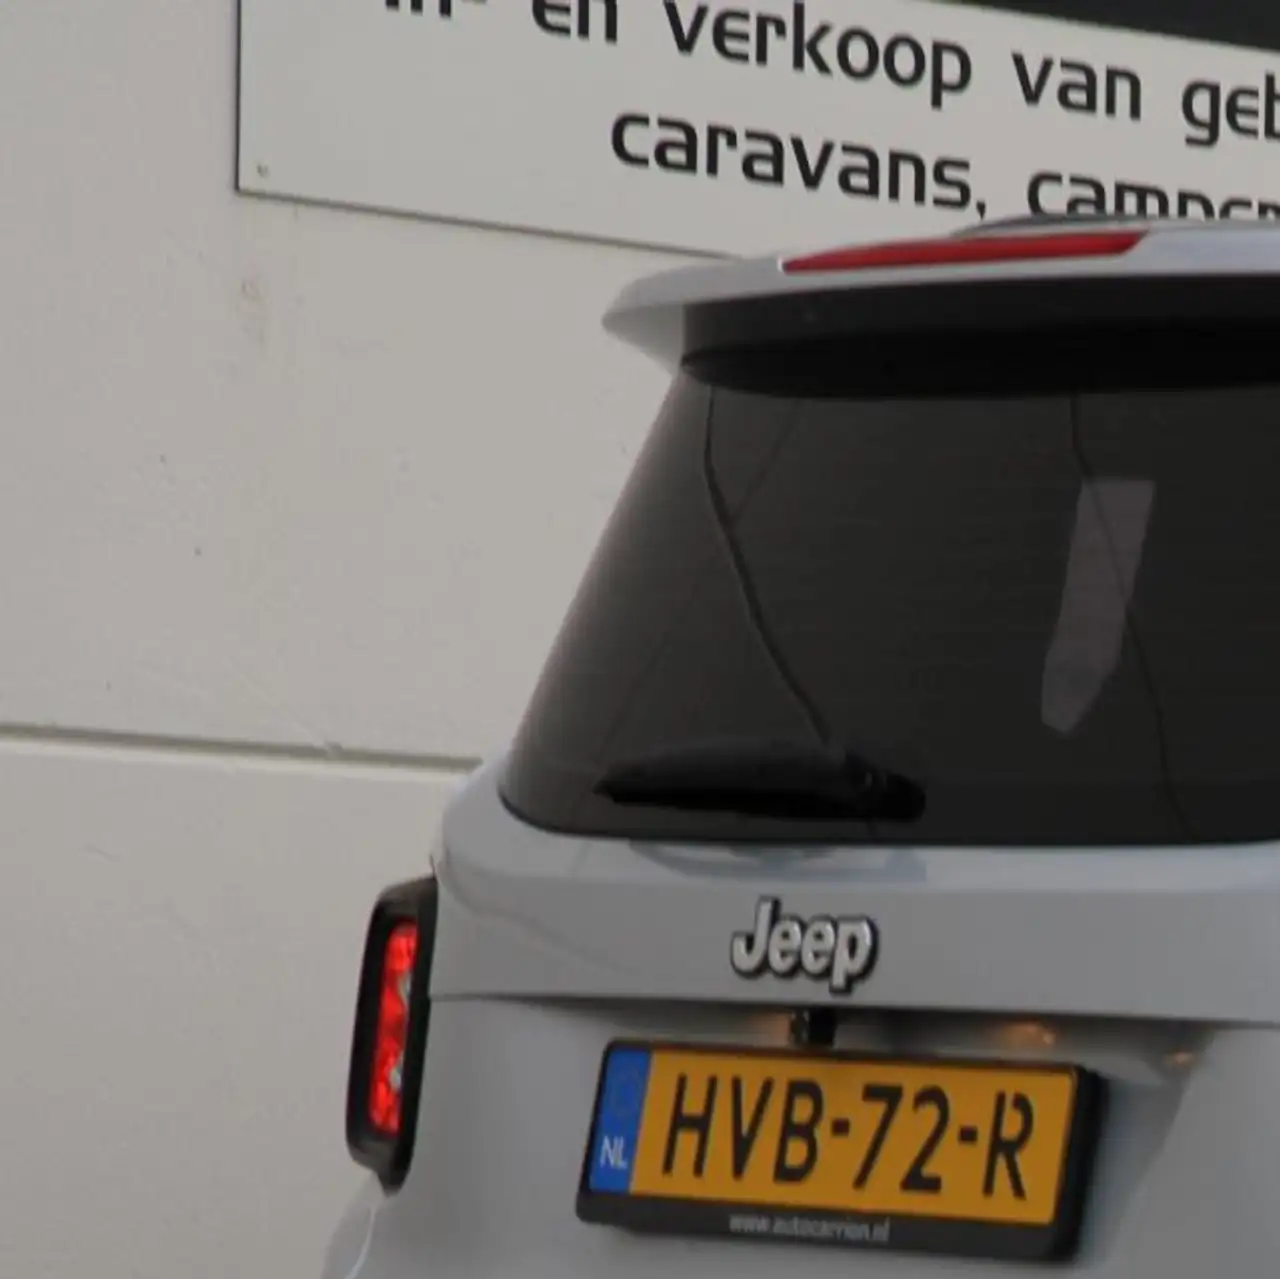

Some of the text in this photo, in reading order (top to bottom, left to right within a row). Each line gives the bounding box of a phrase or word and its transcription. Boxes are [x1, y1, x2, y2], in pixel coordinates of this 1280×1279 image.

[664, 0, 973, 108] verkoop
[1011, 53, 1142, 121] van
[610, 111, 988, 220] caravans,
[730, 897, 878, 995] Jeep
[599, 1136, 628, 1170] NL
[661, 1074, 1034, 1201] HVB-72-R
